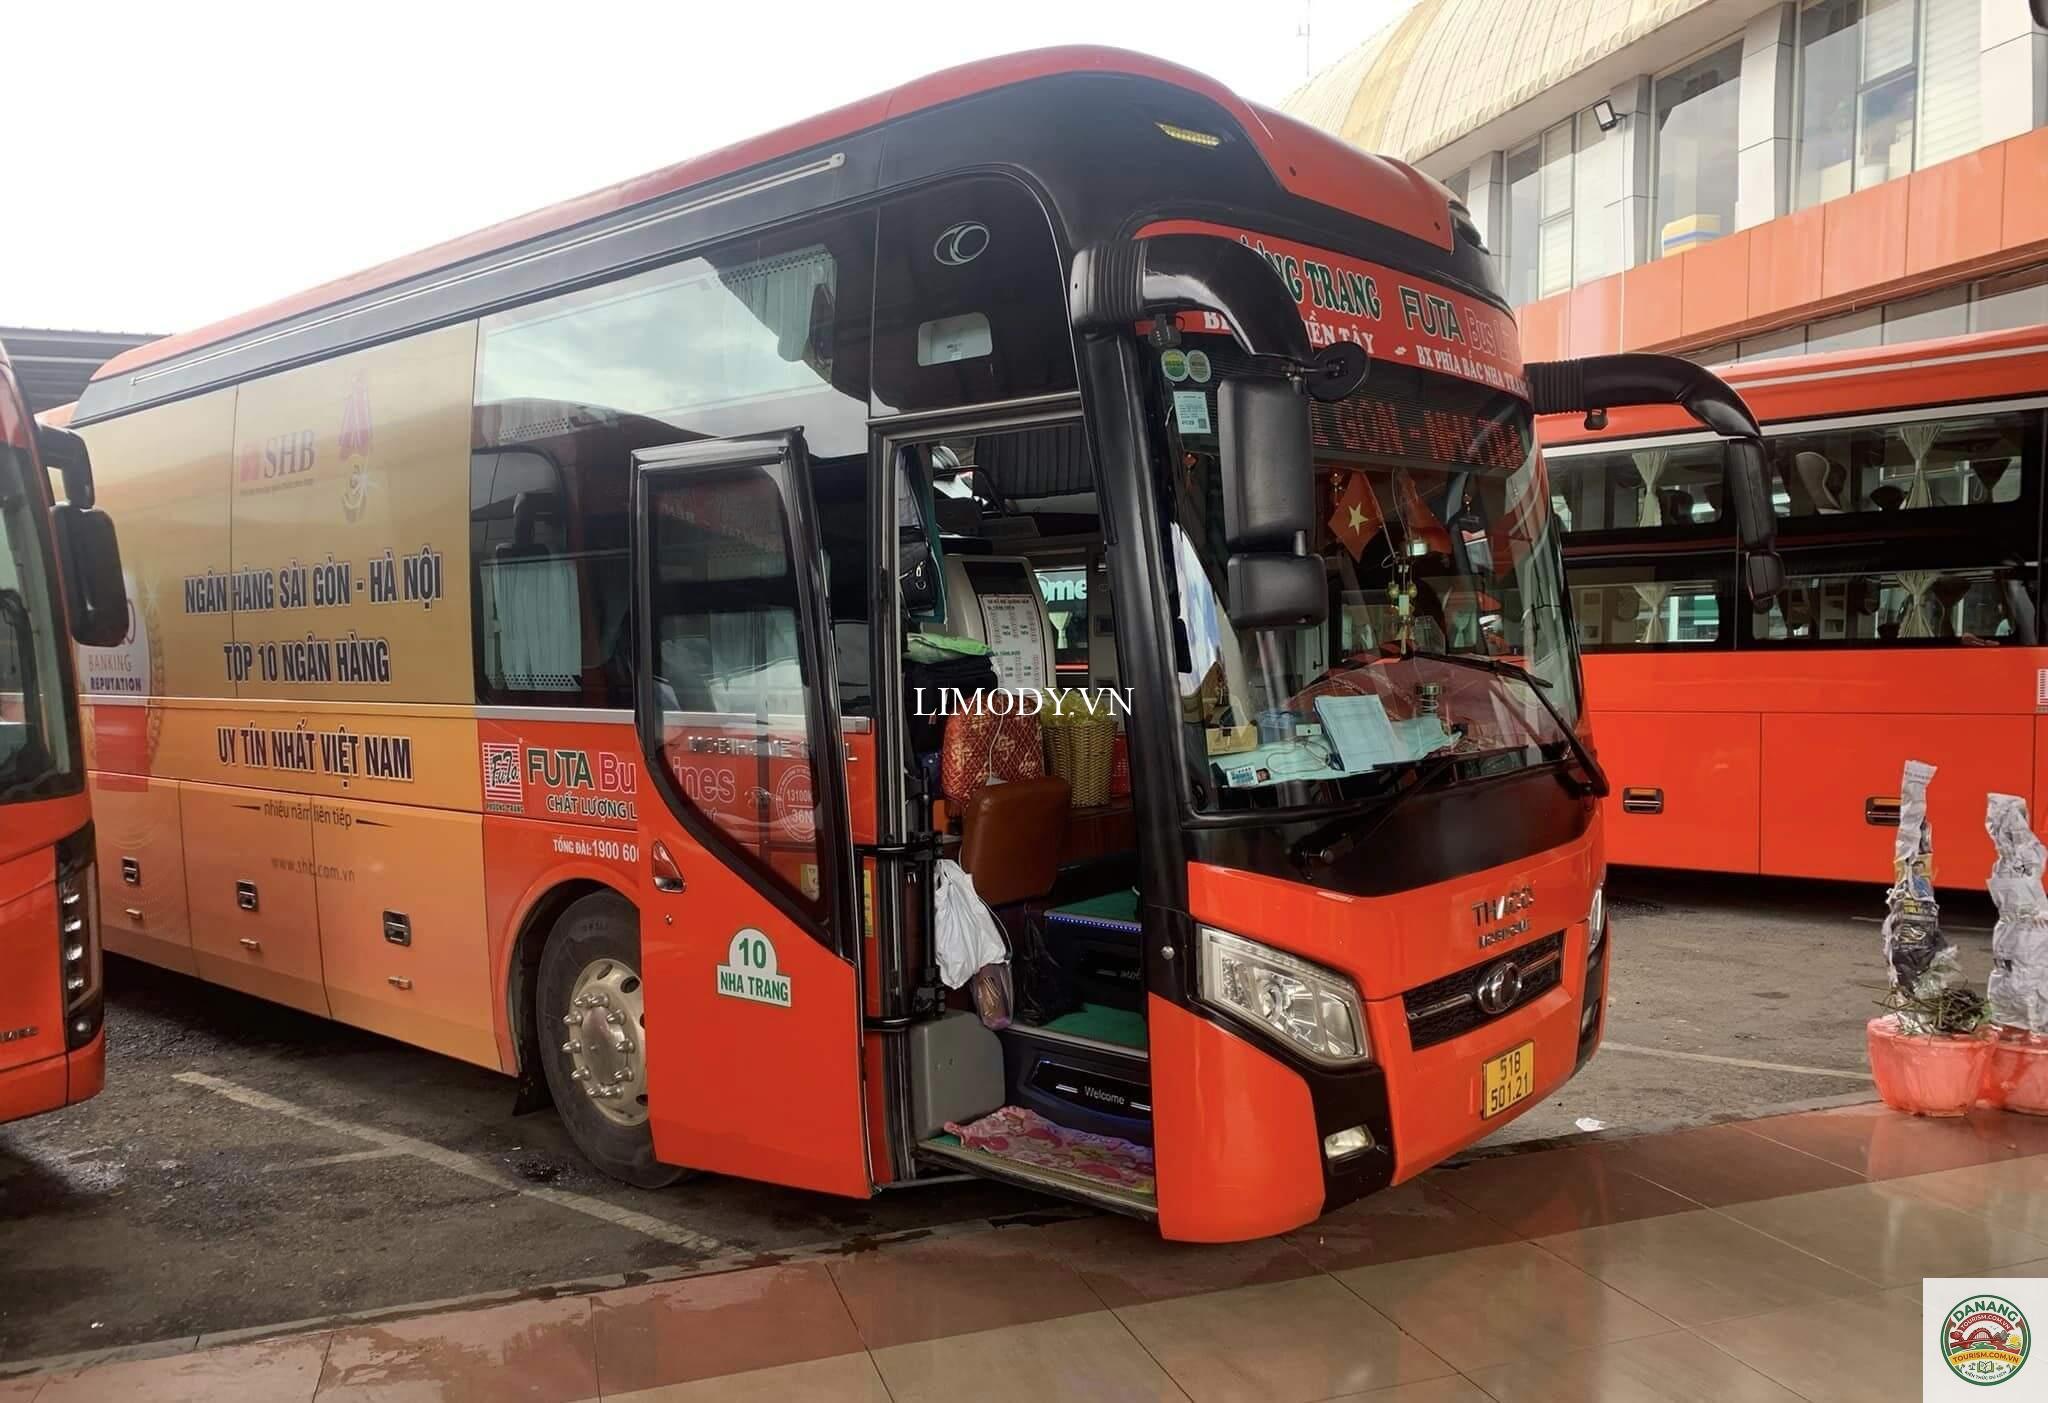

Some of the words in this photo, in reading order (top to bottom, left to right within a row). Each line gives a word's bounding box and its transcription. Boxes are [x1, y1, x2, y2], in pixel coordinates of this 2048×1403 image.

[1304, 260, 1381, 321] TRANG
[1398, 284, 1466, 346] FUTA
[1416, 345, 1434, 368] BX
[264, 429, 315, 479] SHB
[184, 566, 228, 615] NGÂN
[230, 563, 275, 612] HÀNG
[279, 558, 307, 609] SÀI
[312, 552, 351, 608] GÒN
[369, 548, 399, 605] HÀ
[402, 544, 442, 612] NỘI
[223, 642, 254, 683] TOP
[257, 642, 278, 683] 10
[281, 631, 333, 684] NGÂN
[335, 630, 391, 685] HÀNG
[90, 676, 142, 692] REPUTATION
[216, 726, 237, 766] UY
[239, 720, 268, 769] TÍN
[271, 717, 316, 773] NHẤT
[319, 724, 360, 790] VIỆT
[363, 734, 414, 783] NAM
[526, 747, 595, 791] FUTA
[599, 751, 637, 794] Bu
[672, 756, 737, 804] ines
[546, 789, 579, 813] CHẤT
[580, 796, 627, 822] LƯỢNG
[592, 838, 620, 860] 1900
[622, 843, 639, 863] 60
[738, 937, 767, 969] 10
[720, 970, 745, 994] NHA
[747, 975, 788, 1002] TRANG
[1500, 1051, 1521, 1079] 51B
[1084, 1085, 1125, 1105] Welcome
[1490, 1077, 1529, 1113] 501.21
